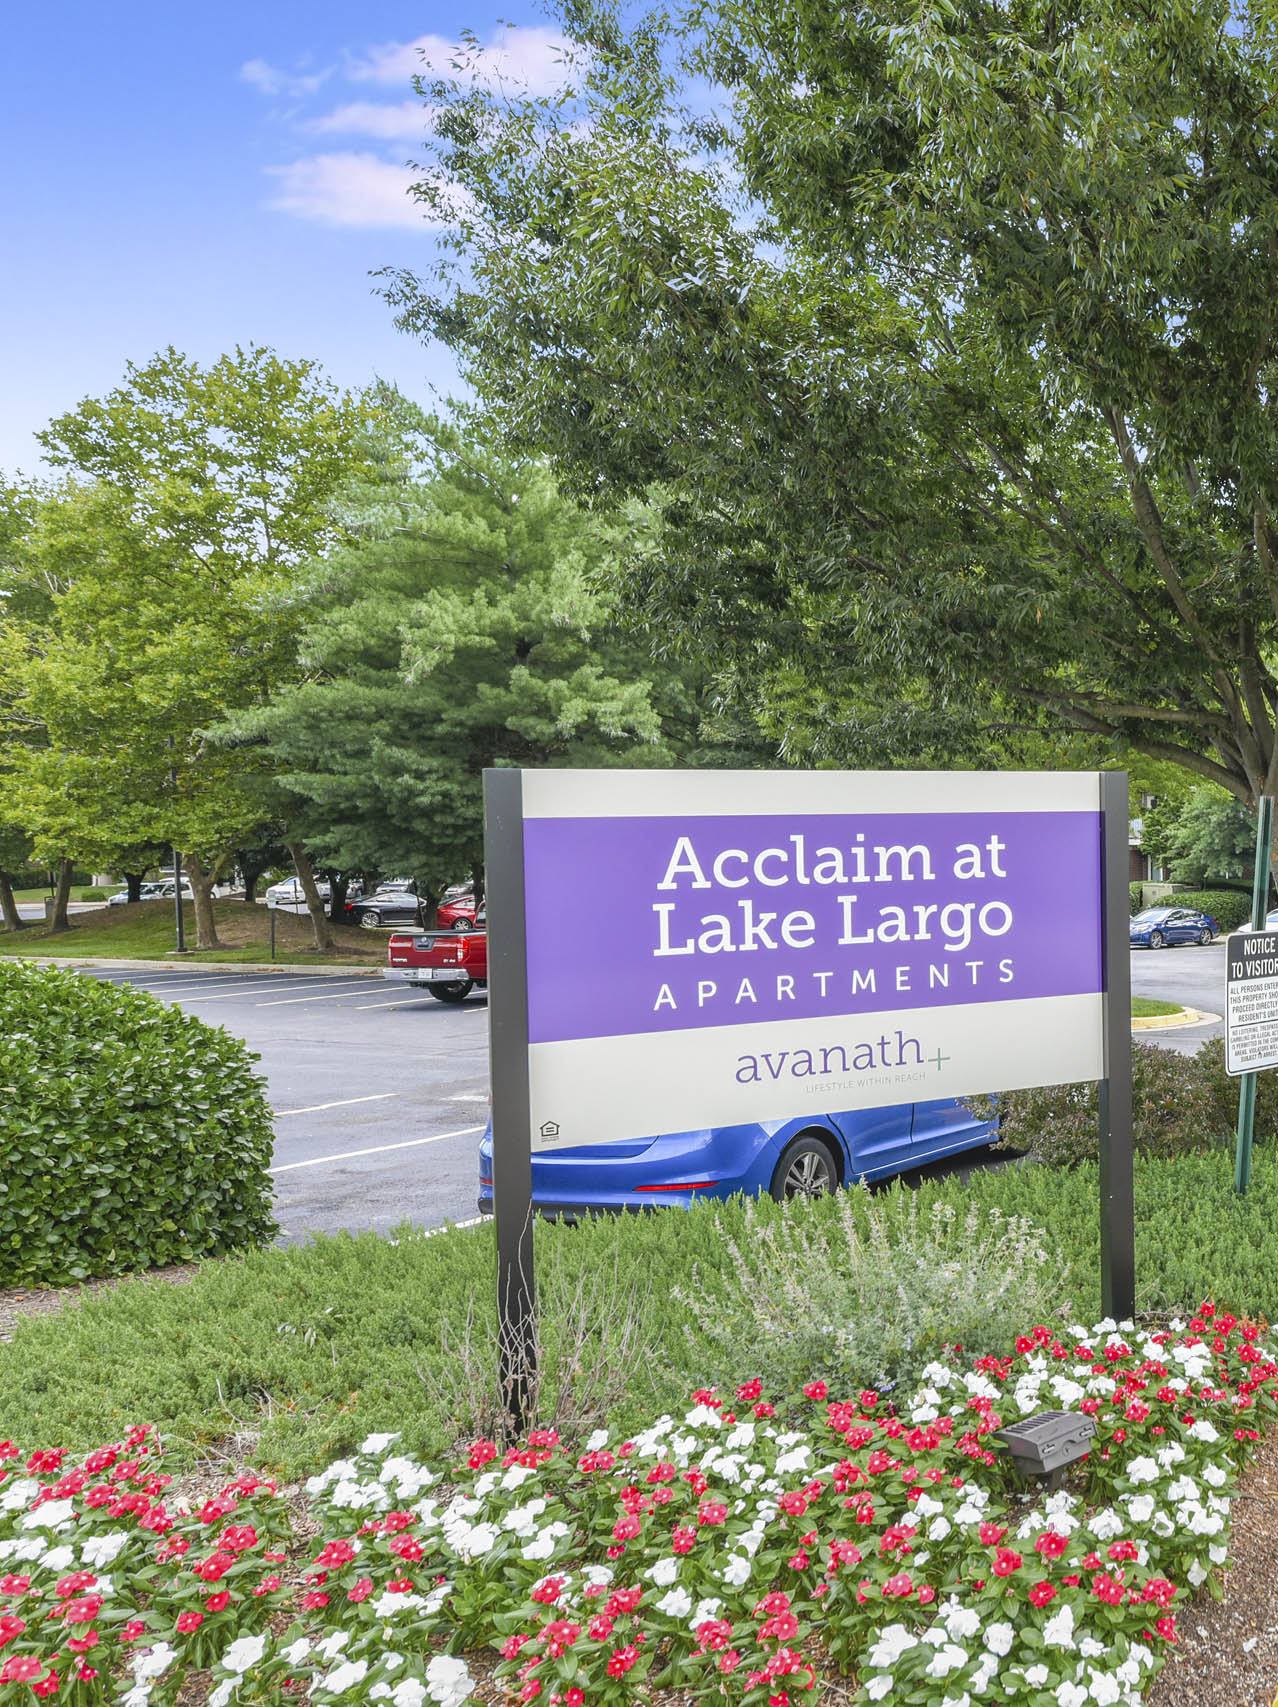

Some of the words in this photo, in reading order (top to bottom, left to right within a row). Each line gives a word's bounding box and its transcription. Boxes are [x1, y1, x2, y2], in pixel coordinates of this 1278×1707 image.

[656, 833, 937, 891] Acclaim
[953, 834, 1007, 880] at
[652, 899, 817, 957] Lake
[837, 894, 1014, 953] Largo
[1244, 937, 1276, 956] NOTICE
[1231, 961, 1243, 978] TO
[653, 958, 1015, 1012] APARTMENTS
[1230, 986, 1239, 994] ALL
[1240, 983, 1263, 992] PERSONS
[1232, 1004, 1254, 1013] PROCEED
[1256, 1000, 1277, 1010] DIRECTLY
[1242, 993, 1267, 1002] PROPERTY
[1238, 1011, 1266, 1022] RESIDENT'S
[806, 1079, 854, 1094] LIFESTYLE
[856, 1075, 892, 1089] WITHIN
[895, 1071, 927, 1084] REACH
